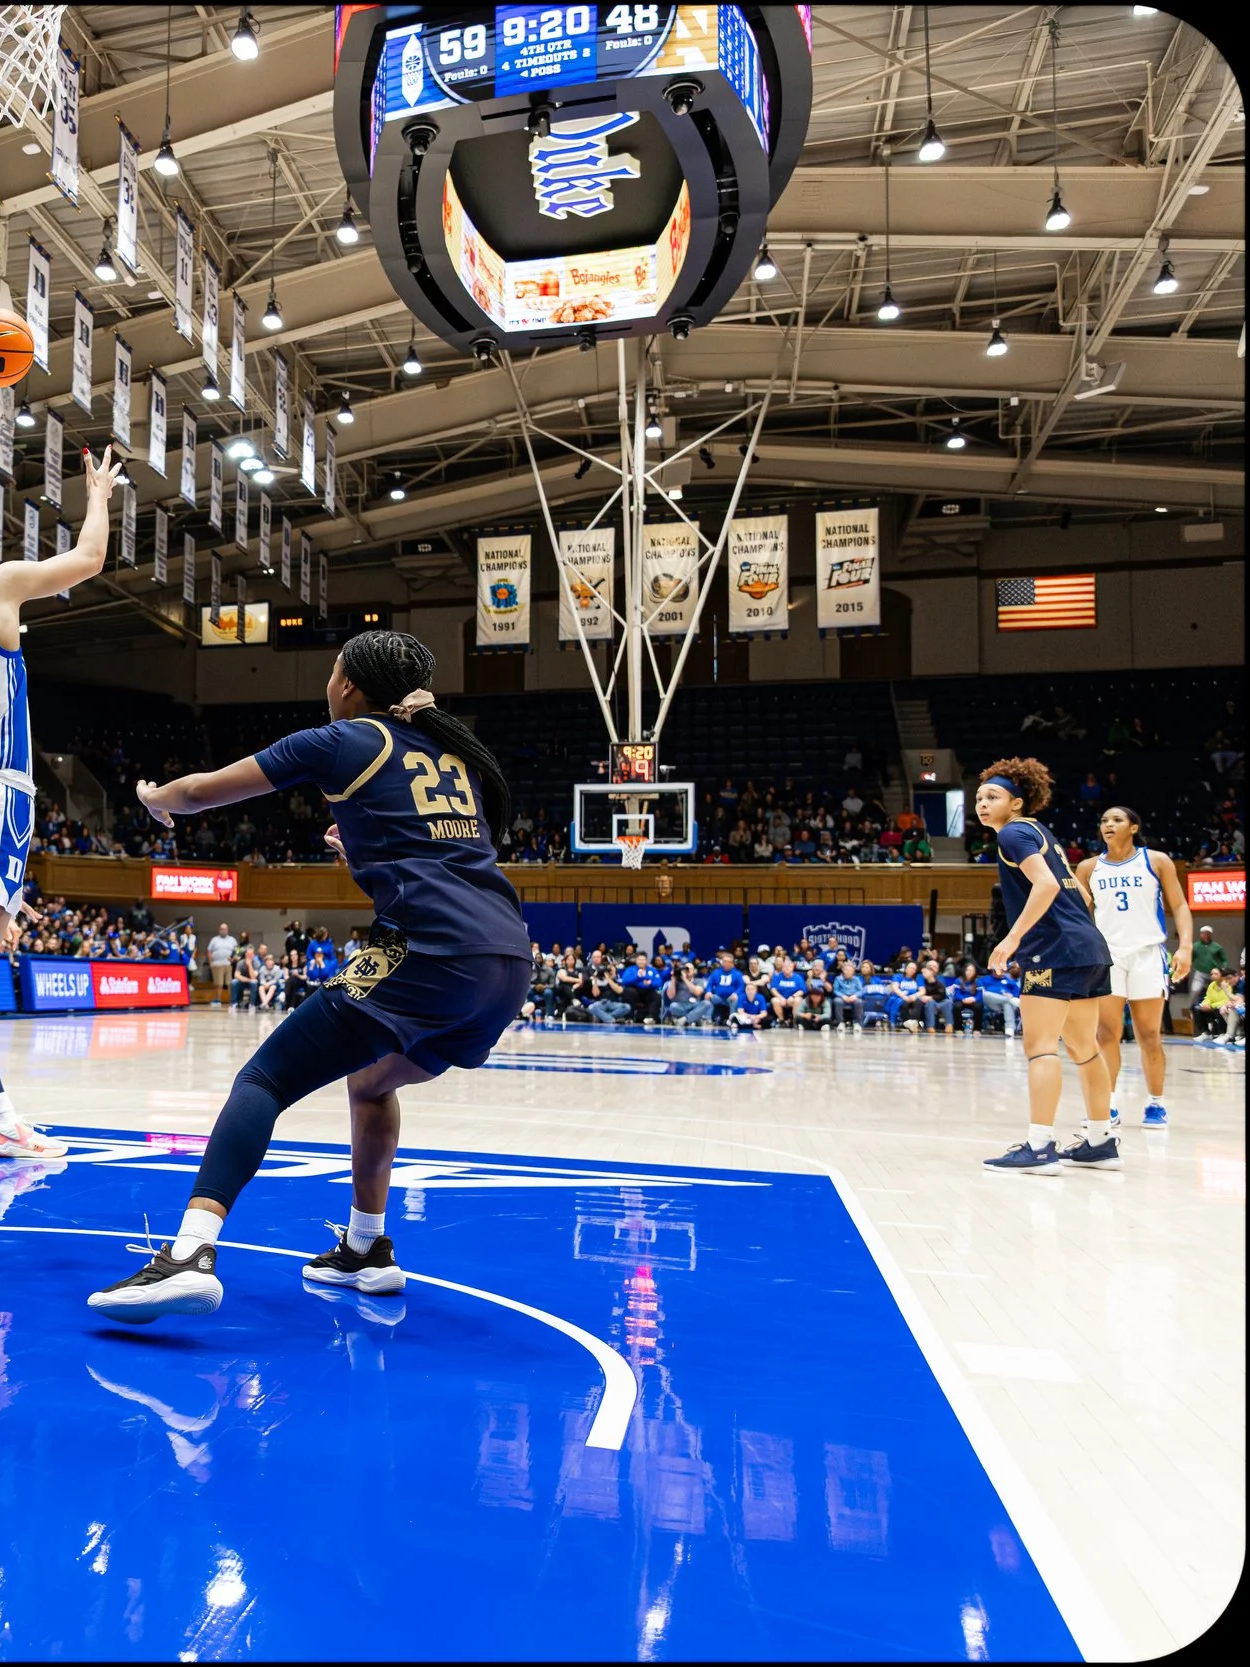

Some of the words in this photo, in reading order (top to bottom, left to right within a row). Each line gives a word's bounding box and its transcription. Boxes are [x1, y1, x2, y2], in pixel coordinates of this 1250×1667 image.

[503, 6, 590, 47] 9:20
[605, 4, 659, 35] 48
[439, 24, 487, 65] 59
[519, 43, 546, 56] 4TH
[547, 40, 573, 54] QTR
[605, 38, 643, 51] Fouls:
[644, 35, 652, 46] 0
[502, 62, 510, 71] 4
[514, 50, 578, 69] TIMEOUTS
[583, 48, 591, 58] 2
[444, 68, 479, 83] Fouls:
[479, 65, 488, 76] 0
[530, 65, 562, 78] POSS
[60, 94, 77, 135] 35
[570, 268, 620, 286] Bojangles
[825, 523, 870, 537] NATIONAL
[821, 535, 876, 549] CHAMPIONS
[485, 549, 523, 560] NATIONAL
[480, 560, 528, 572] CHAMPIONS
[750, 562, 779, 574] FINAL
[842, 556, 873, 573] FINAL
[739, 571, 779, 587] FOUR
[829, 569, 872, 587] FOUR
[746, 606, 773, 618] 2010
[835, 602, 864, 613] 2015
[280, 618, 303, 627] DUKE
[580, 617, 599, 627] 992
[658, 612, 683, 622] 2001
[492, 622, 515, 632] 1991
[402, 751, 477, 816] 23
[427, 819, 480, 840] MOORE
[5, 855, 23, 884] D
[156, 875, 179, 886] FAN
[180, 876, 214, 888] WORK
[1098, 876, 1142, 890] DUKE
[1193, 881, 1224, 894] FAN
[1115, 891, 1129, 911] 3
[35, 973, 76, 998] WHEELS
[76, 972, 89, 997] UP
